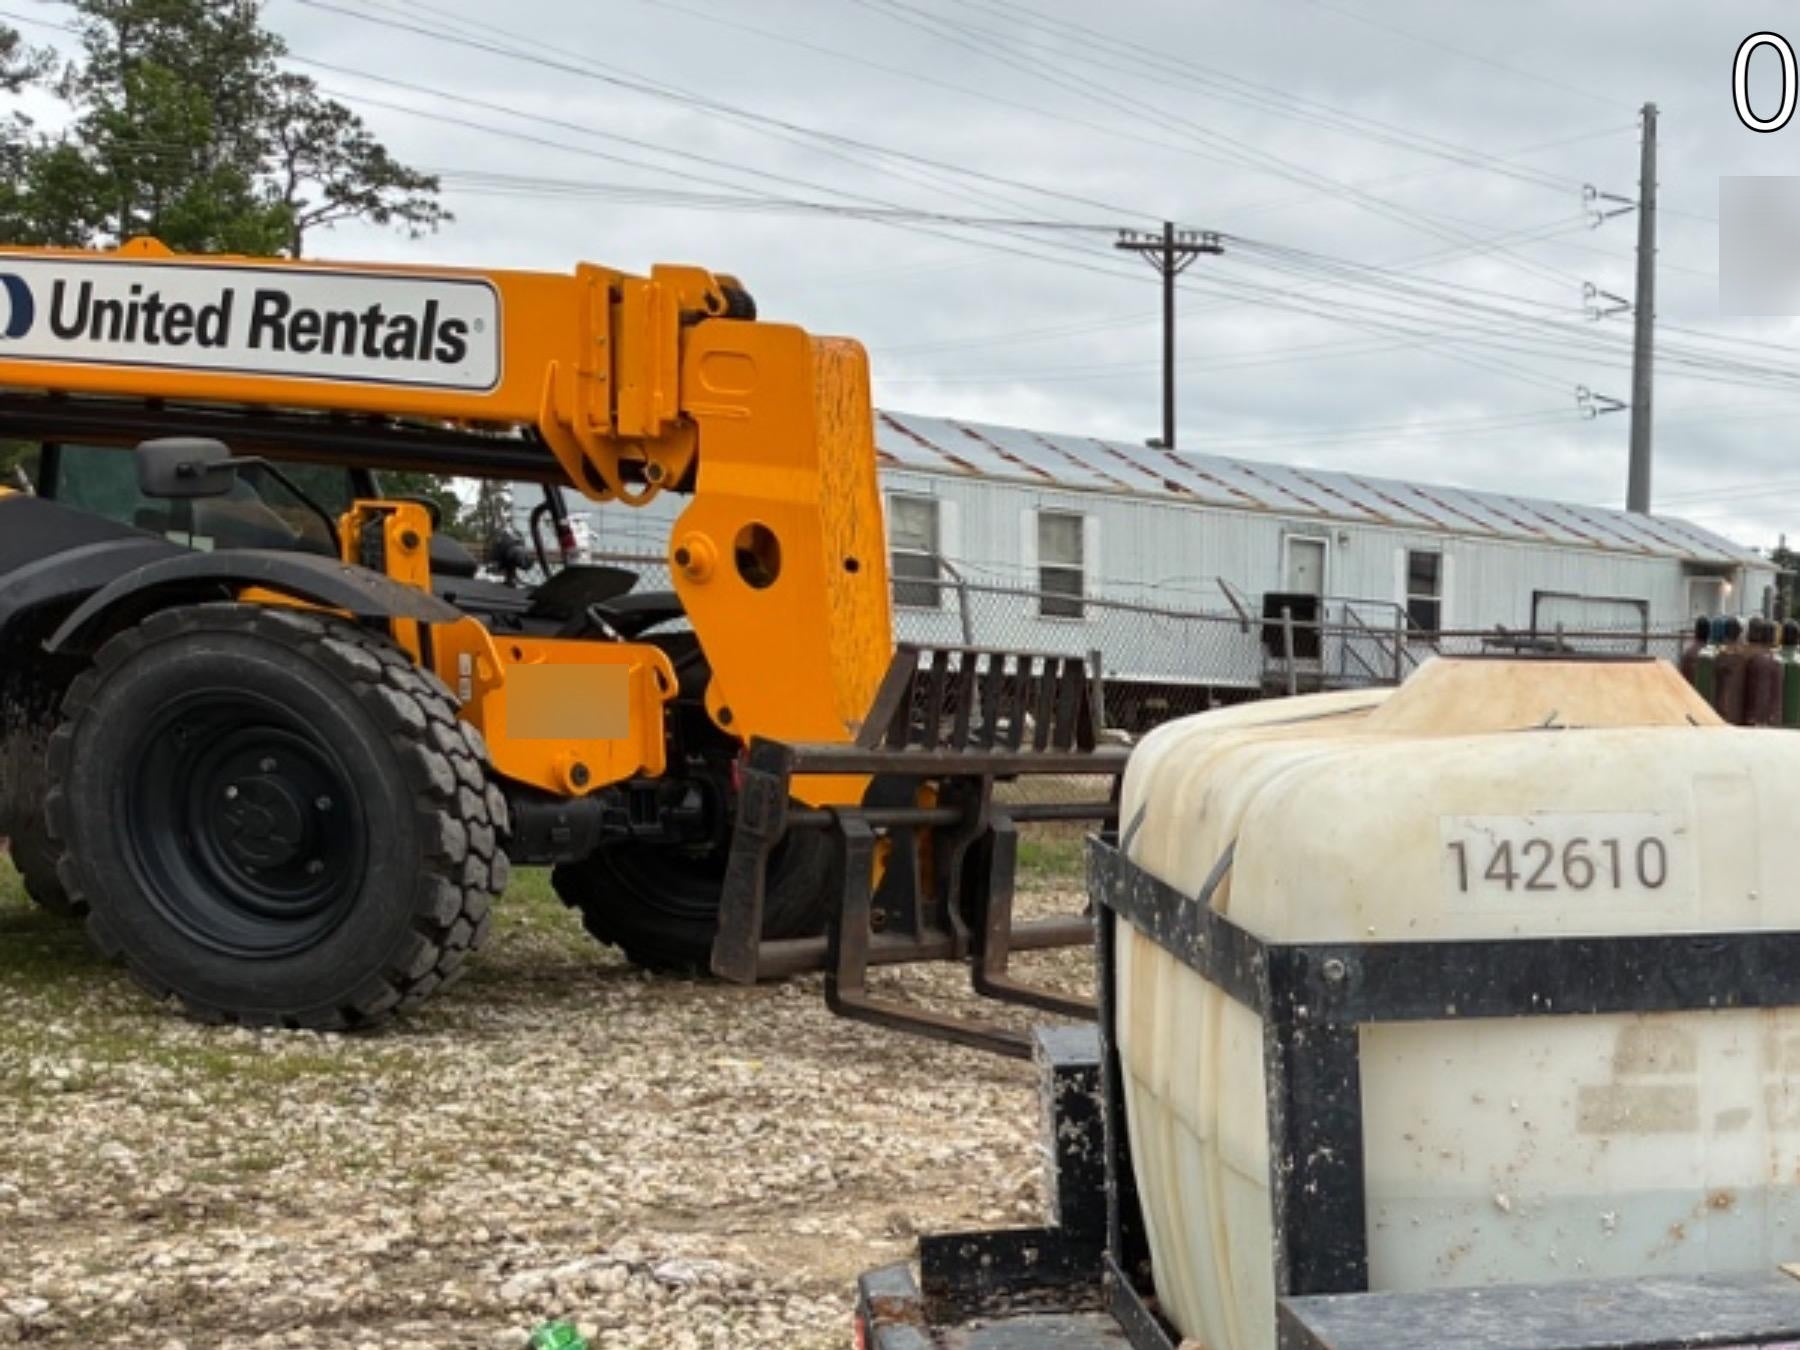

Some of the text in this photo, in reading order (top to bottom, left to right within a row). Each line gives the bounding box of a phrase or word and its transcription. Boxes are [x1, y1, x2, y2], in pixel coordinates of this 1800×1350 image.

[49, 279, 469, 364] United Rentals
[1447, 836, 1668, 892] 142610
